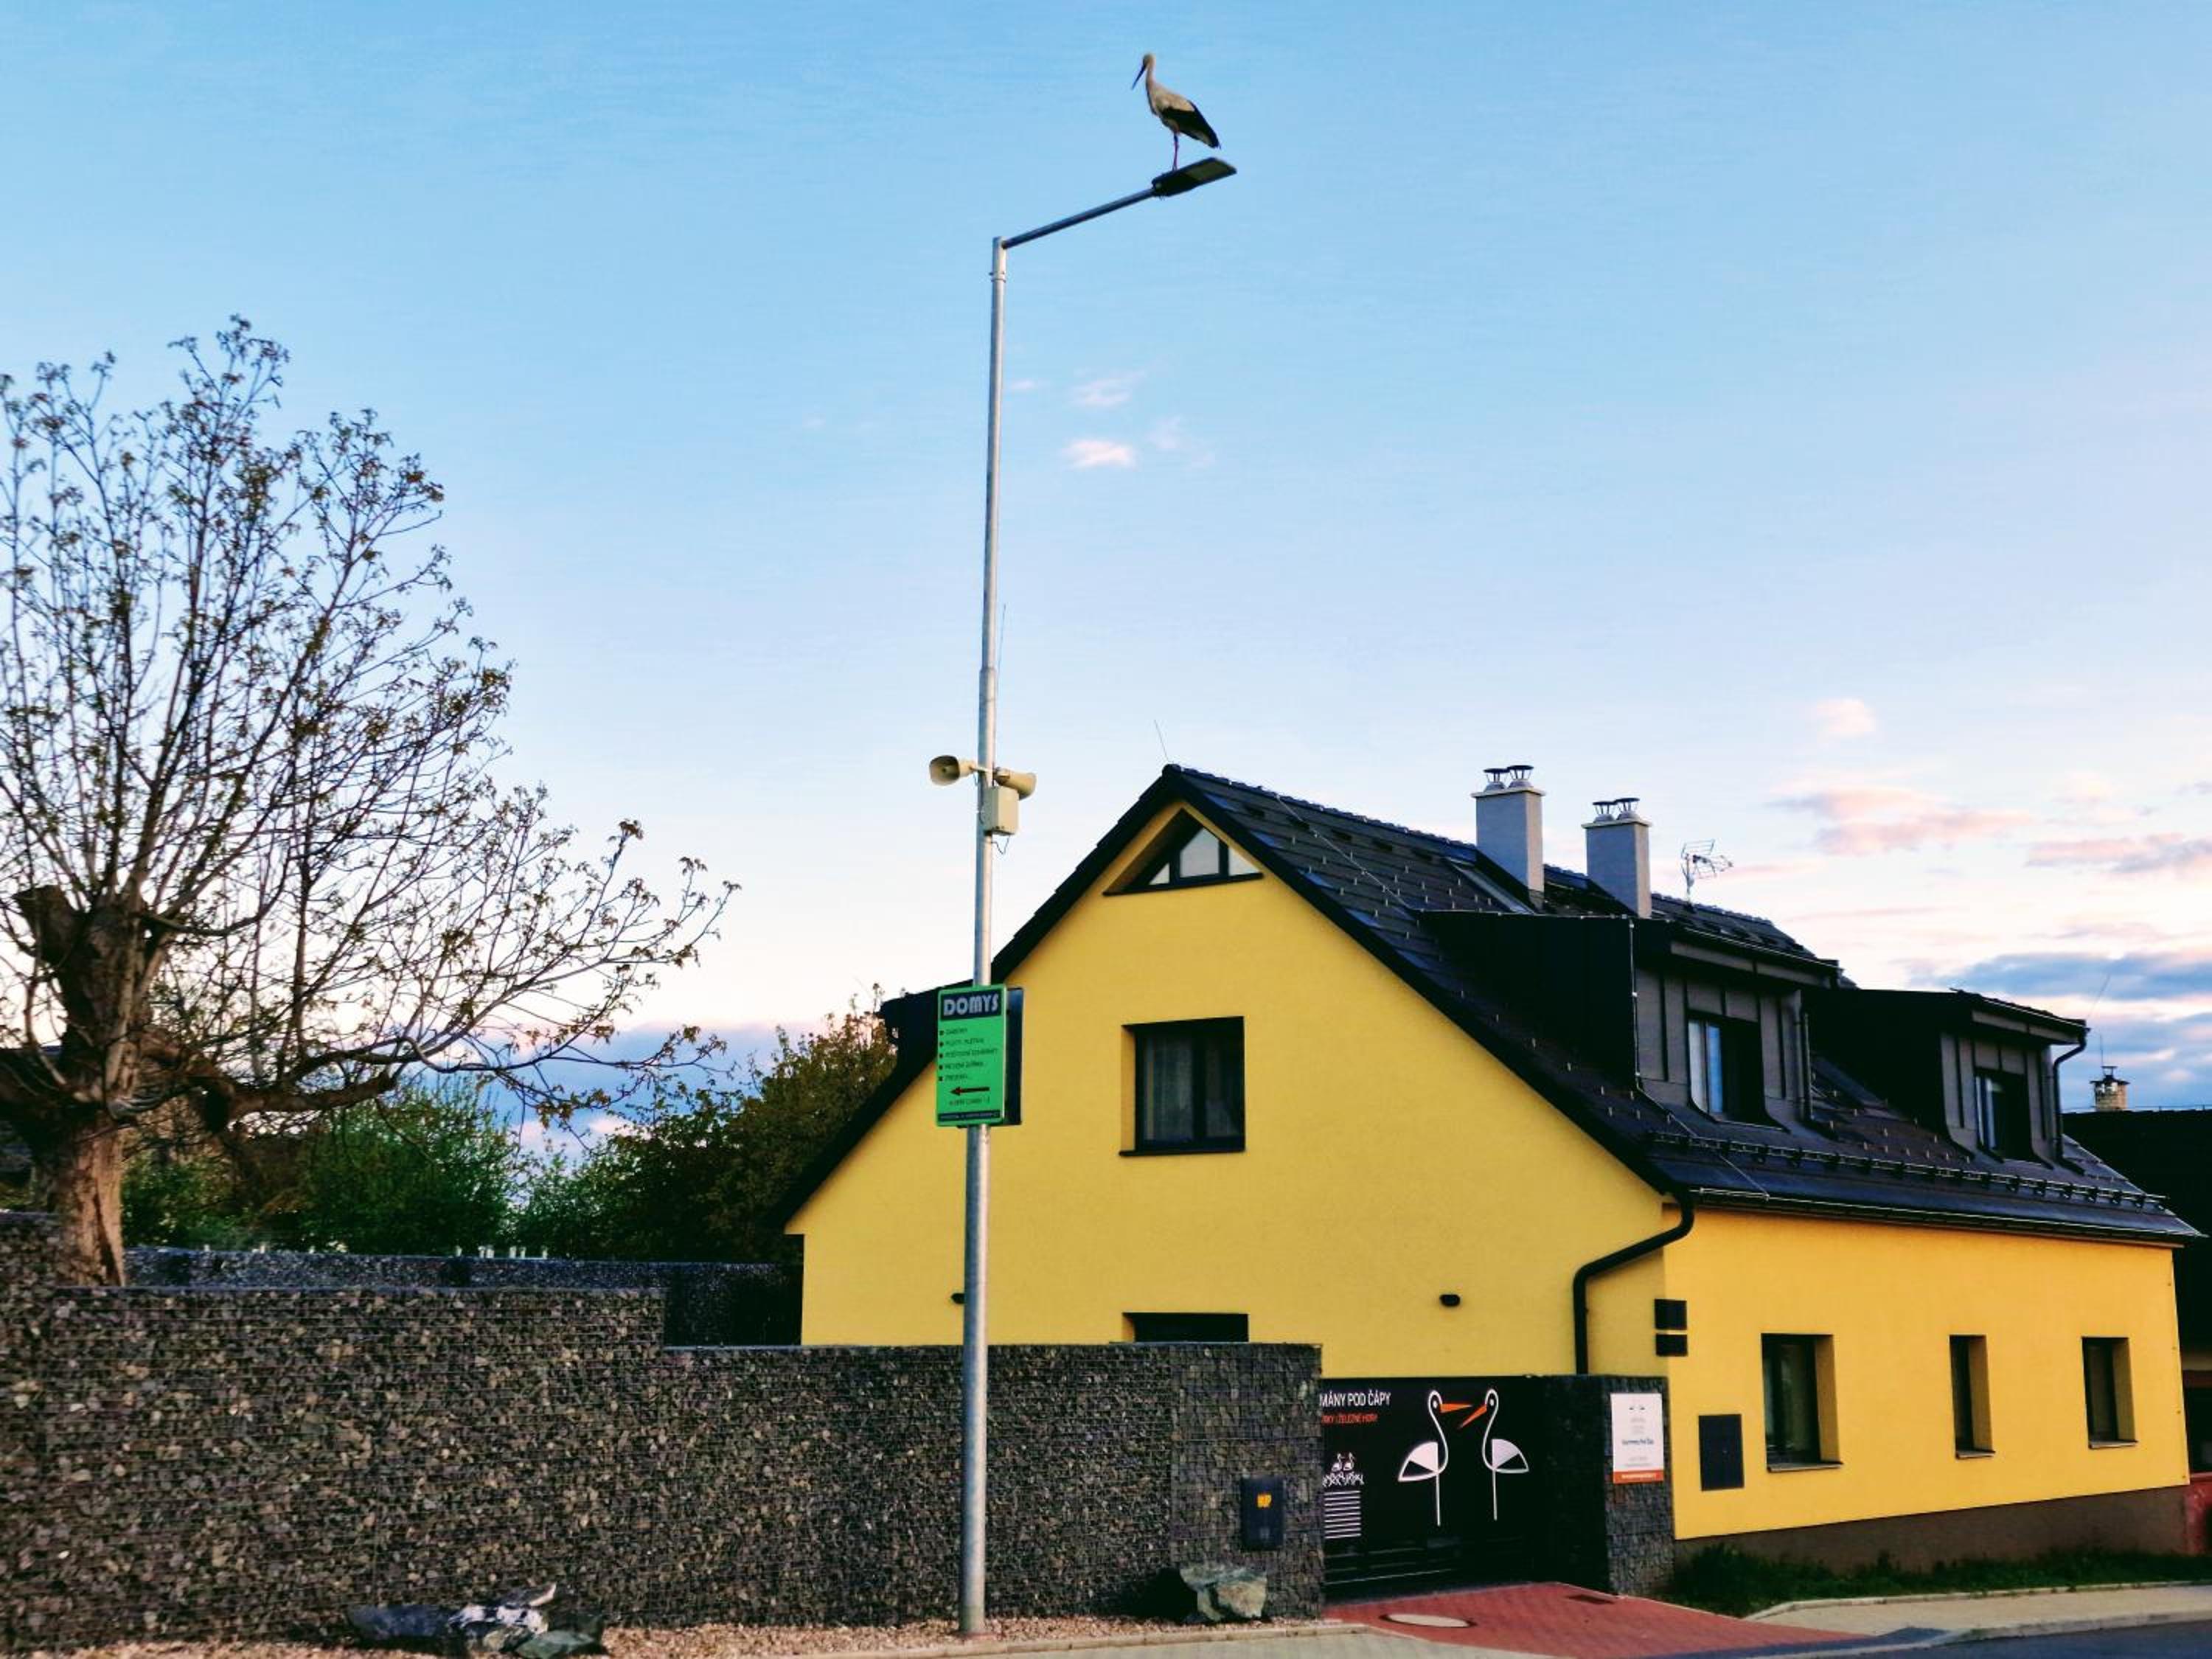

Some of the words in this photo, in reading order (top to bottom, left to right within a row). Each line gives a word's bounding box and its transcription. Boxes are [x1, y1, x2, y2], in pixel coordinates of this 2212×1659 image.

[943, 993, 999, 1016] DOMYS
[1347, 1393, 1366, 1407] POD
[1368, 1389, 1391, 1406] ČÁPY
